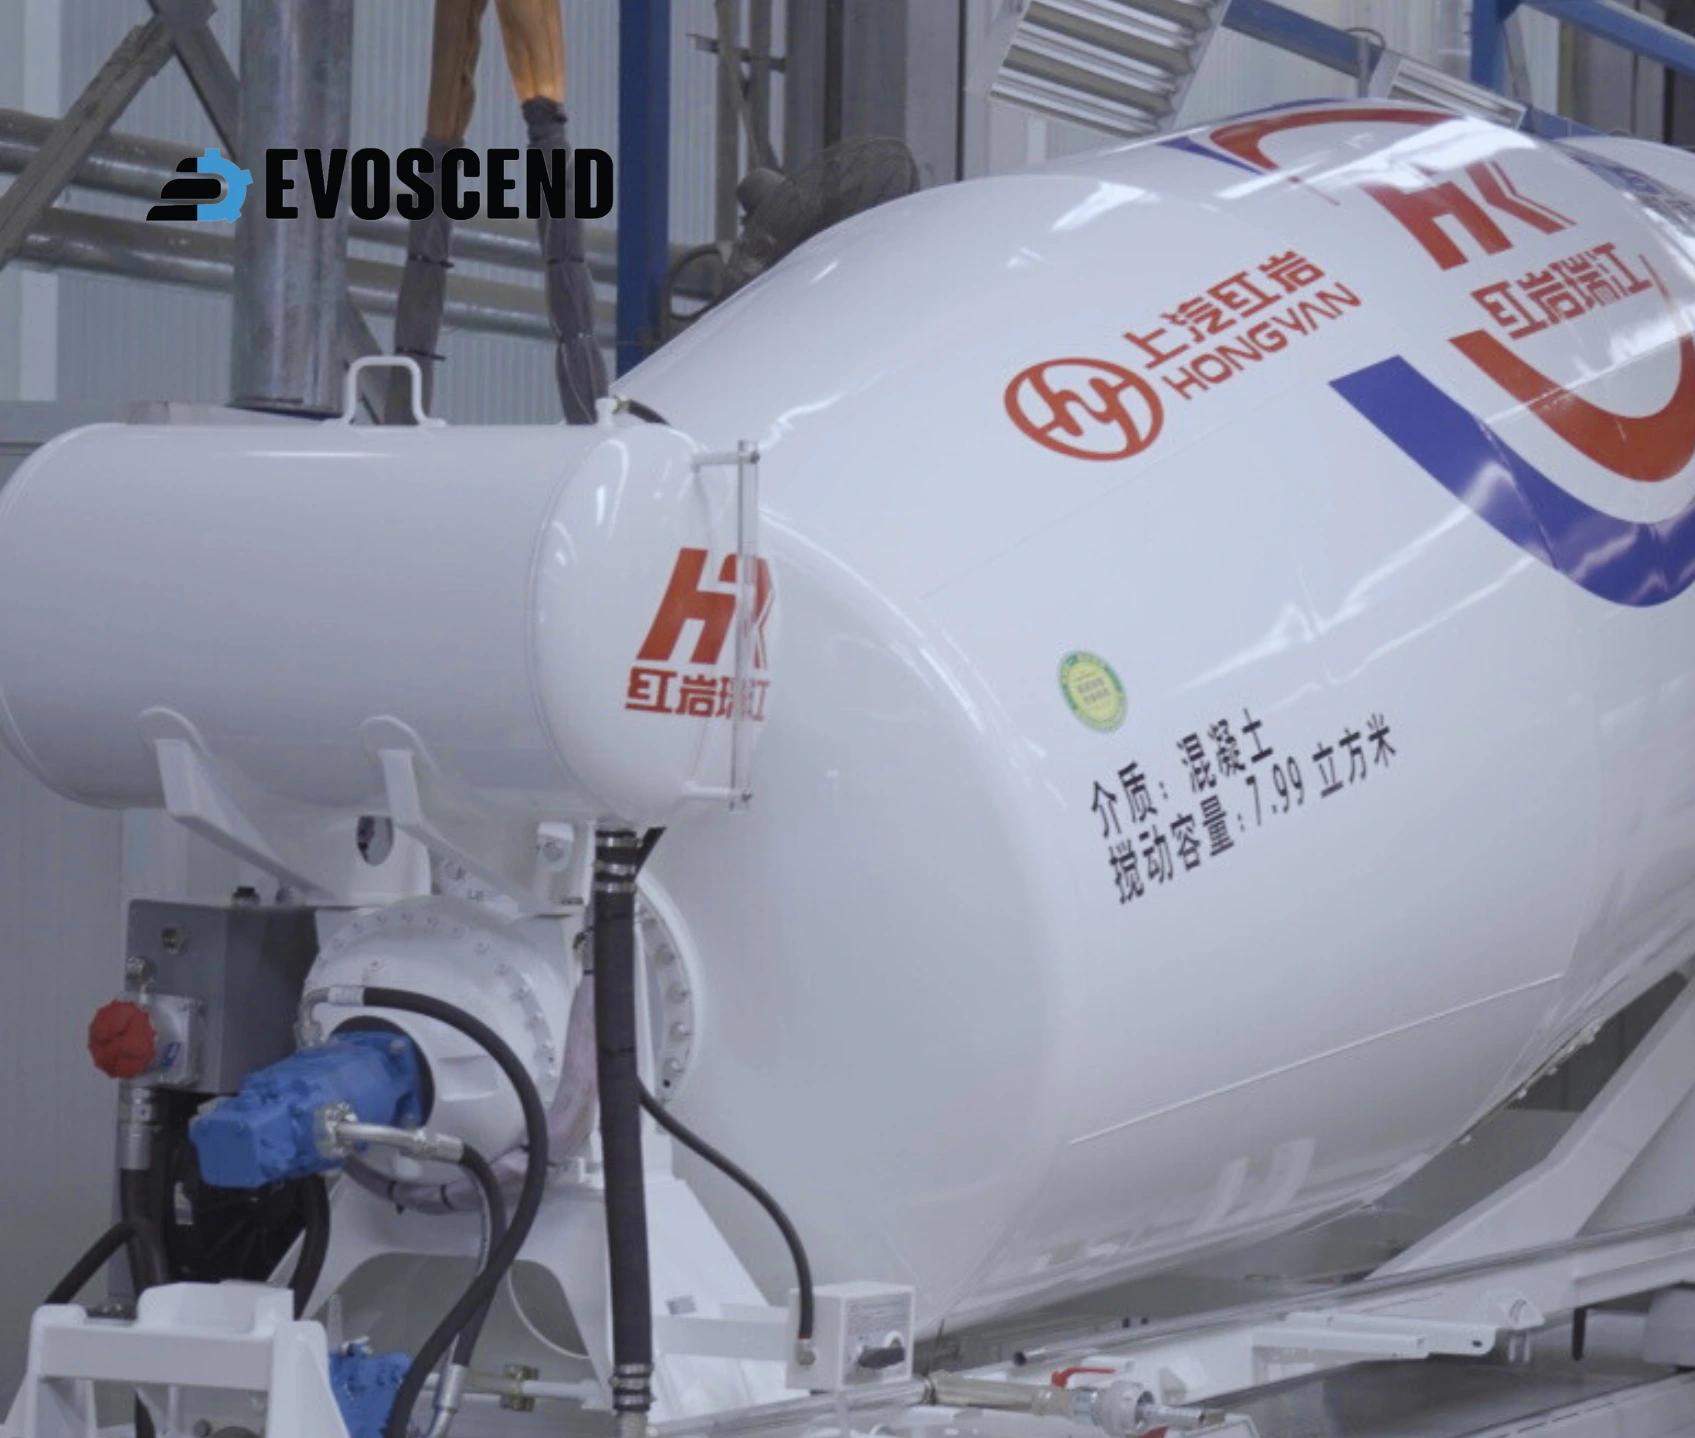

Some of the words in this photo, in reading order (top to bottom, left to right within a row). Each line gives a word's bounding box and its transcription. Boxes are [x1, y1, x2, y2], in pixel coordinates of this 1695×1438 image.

[1122, 250, 1326, 370] 上汽红岩
[1161, 281, 1363, 401] HONGYAN
